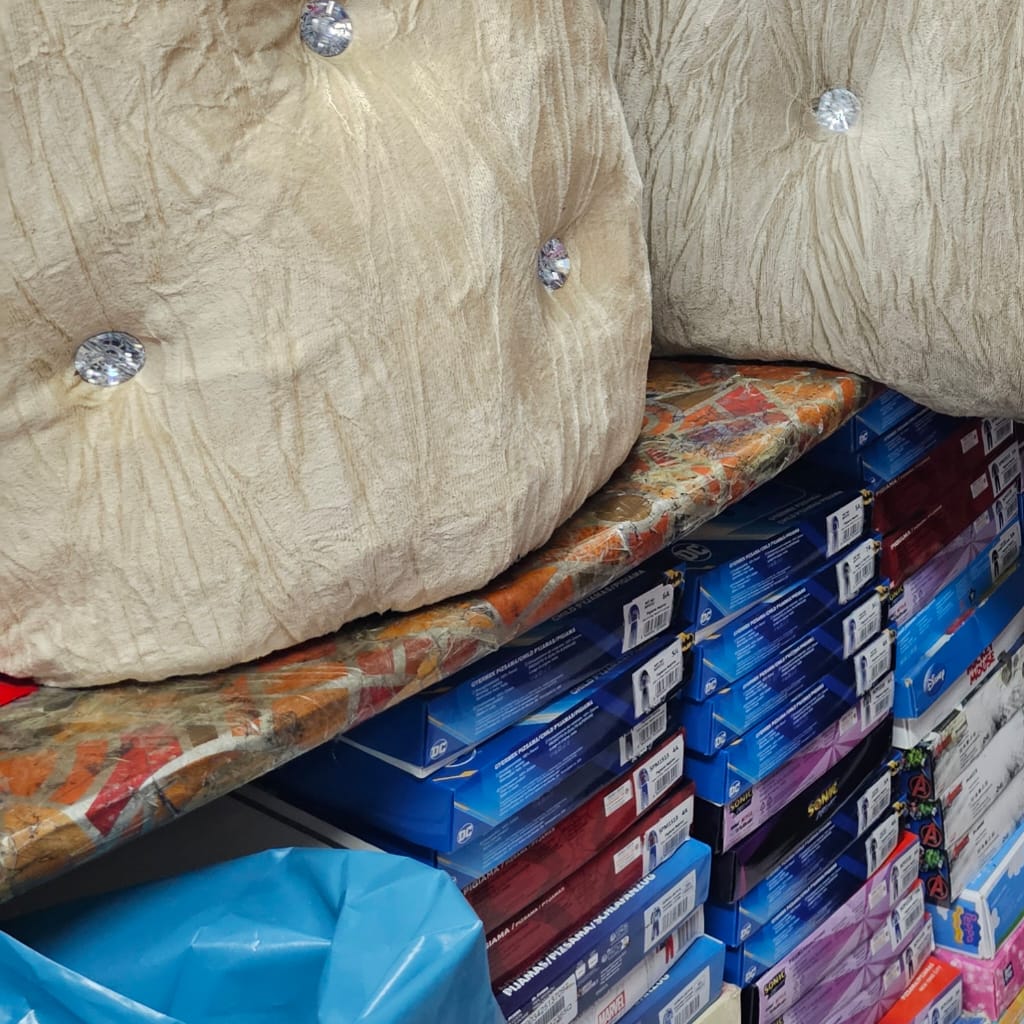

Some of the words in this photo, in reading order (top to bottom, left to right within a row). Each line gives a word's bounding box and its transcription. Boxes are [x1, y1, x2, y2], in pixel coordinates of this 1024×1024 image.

[430, 739, 448, 760] DC
[730, 790, 753, 812] SONIC
[808, 782, 839, 817] SONIC
[457, 823, 474, 844] DC
[764, 968, 786, 996] SONIC
